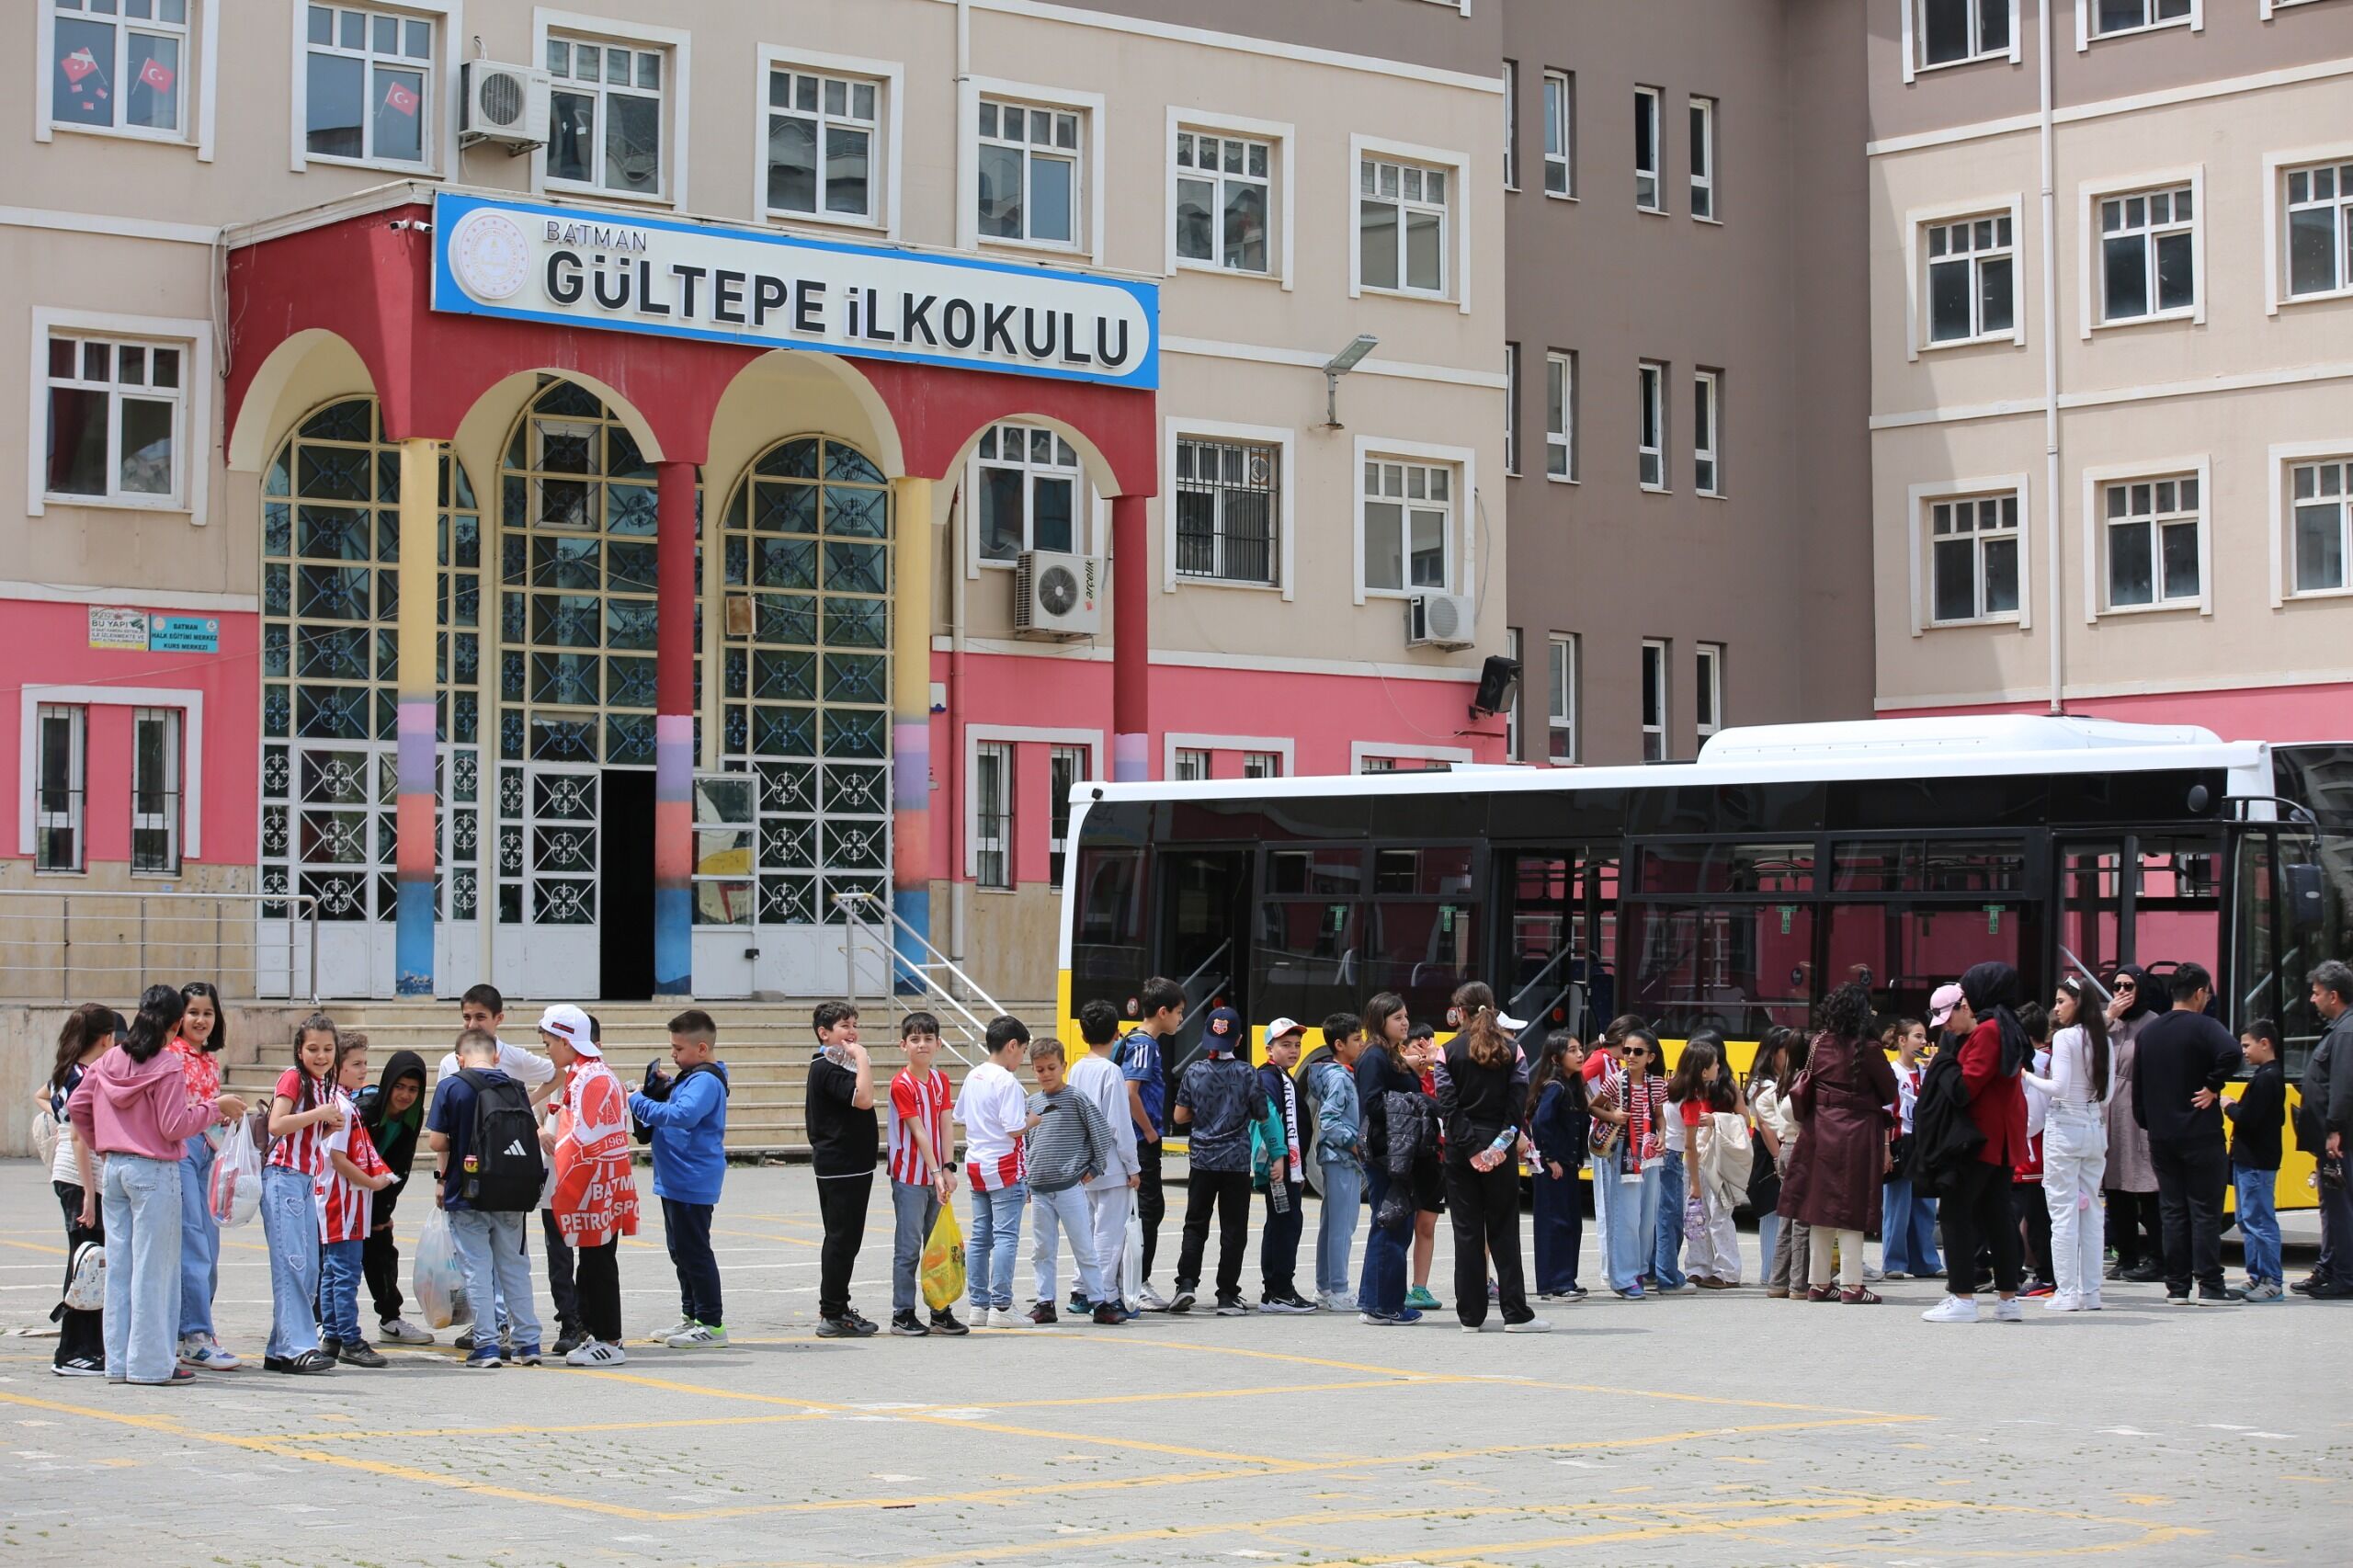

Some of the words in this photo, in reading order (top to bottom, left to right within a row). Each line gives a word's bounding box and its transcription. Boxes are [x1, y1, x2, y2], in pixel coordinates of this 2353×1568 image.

[545, 220, 648, 253] BATMAN
[546, 248, 827, 335] GÜLTEPE
[1085, 560, 1095, 599] arçelik
[592, 1175, 637, 1201] BATM
